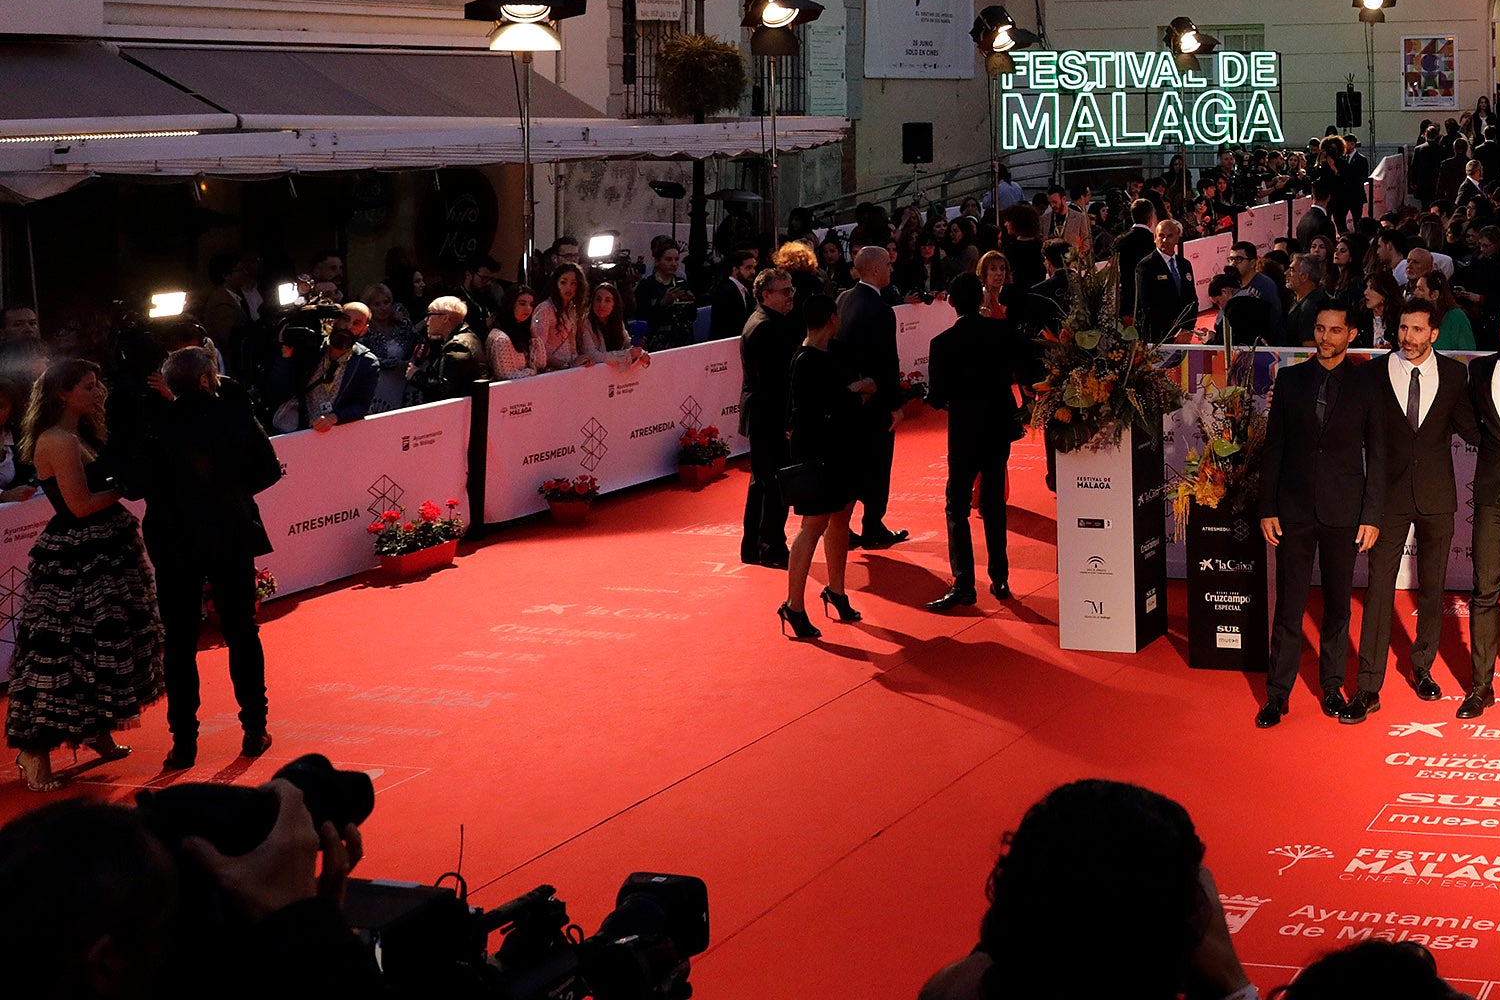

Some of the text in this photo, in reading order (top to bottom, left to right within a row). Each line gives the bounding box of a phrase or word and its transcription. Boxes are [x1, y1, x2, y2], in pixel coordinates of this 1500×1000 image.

[1218, 51, 1278, 88] DE
[1001, 81, 1285, 150] MÁLAGA
[720, 403, 740, 416] ATRES
[630, 421, 675, 440] ATRESMEDIA
[522, 445, 576, 466] ATRESMEDIA
[287, 508, 361, 536] ATRESMEDIA
[1204, 592, 1251, 605] Cruzcampo
[1216, 625, 1240, 633] SUR
[1338, 873, 1393, 884] CINE
[1399, 875, 1433, 886] EN
[1278, 922, 1481, 950] de Málaga
